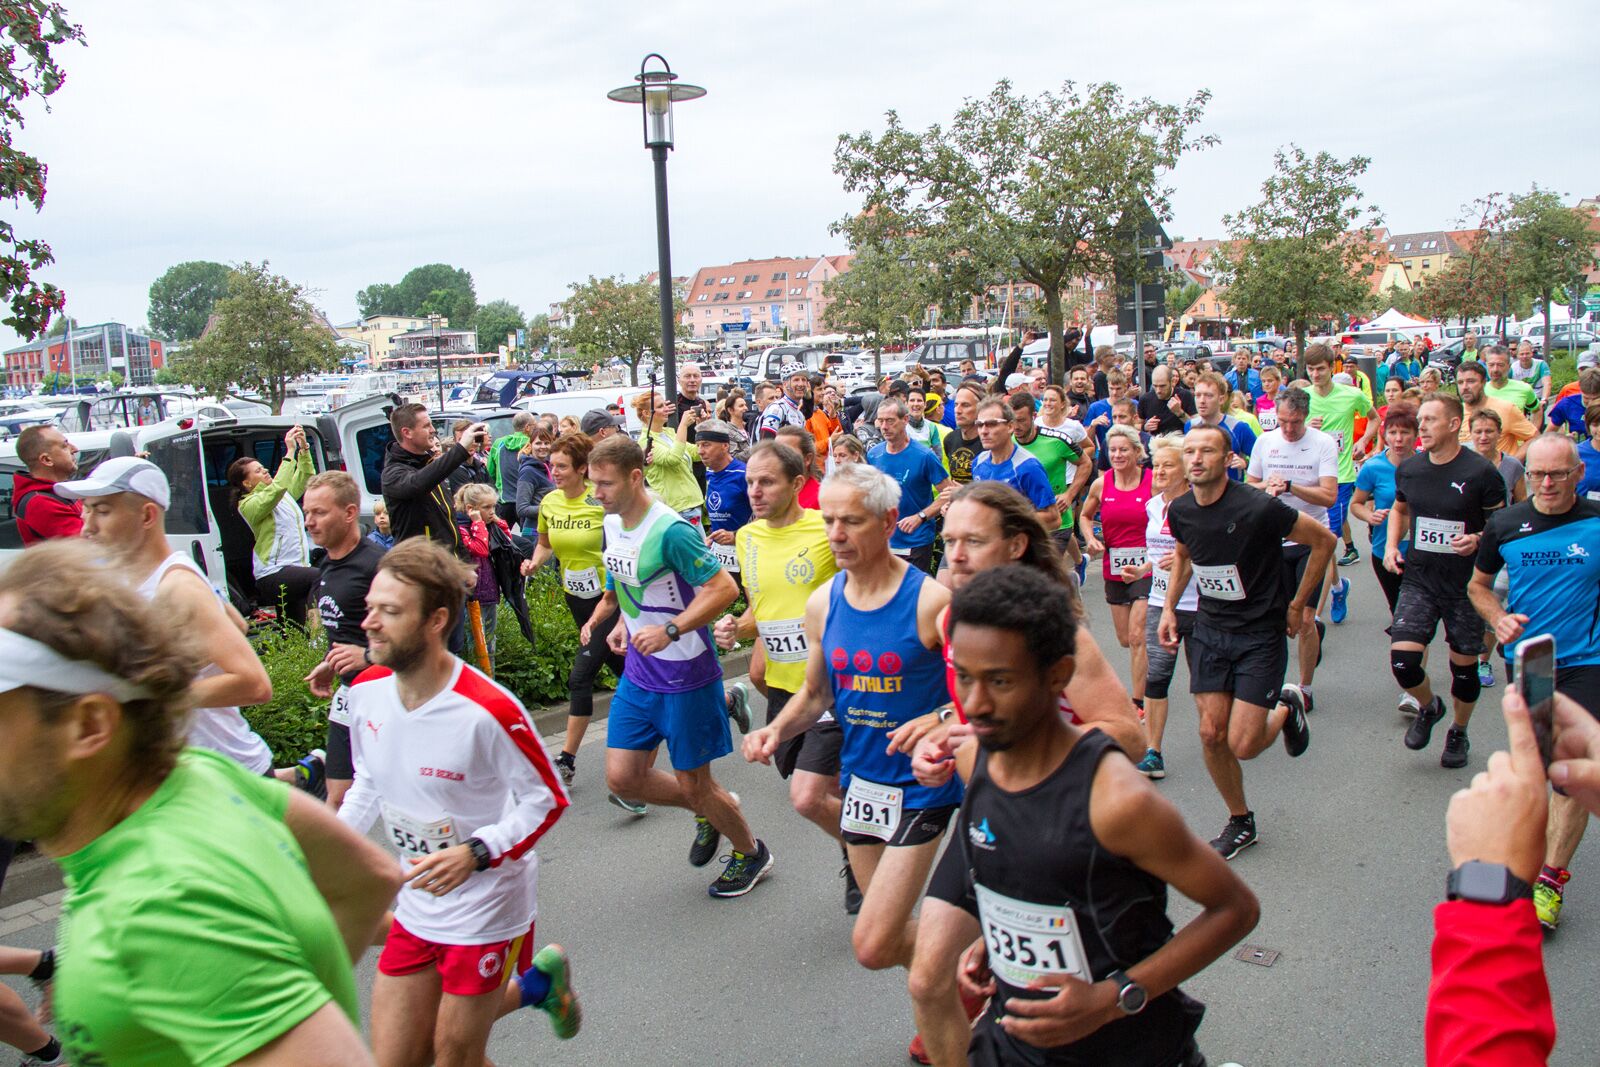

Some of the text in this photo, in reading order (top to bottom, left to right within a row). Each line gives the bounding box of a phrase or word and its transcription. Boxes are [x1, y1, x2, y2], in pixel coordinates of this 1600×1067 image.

[550, 515, 591, 530] Andrea
[1420, 530, 1456, 545] 561.
[1520, 550, 1561, 559] WIND
[606, 556, 632, 577] 531.1
[1114, 556, 1145, 568] 544.1
[1521, 558, 1585, 567] STOPPER
[791, 564, 807, 577] 50
[567, 580, 595, 592] 558.1
[1200, 577, 1236, 592] 555.1
[764, 634, 807, 653] 521.1
[847, 706, 888, 718] Güstrower
[435, 769, 465, 781] BERLIN
[845, 797, 889, 826] 519.1
[989, 923, 1068, 969] 535.1
